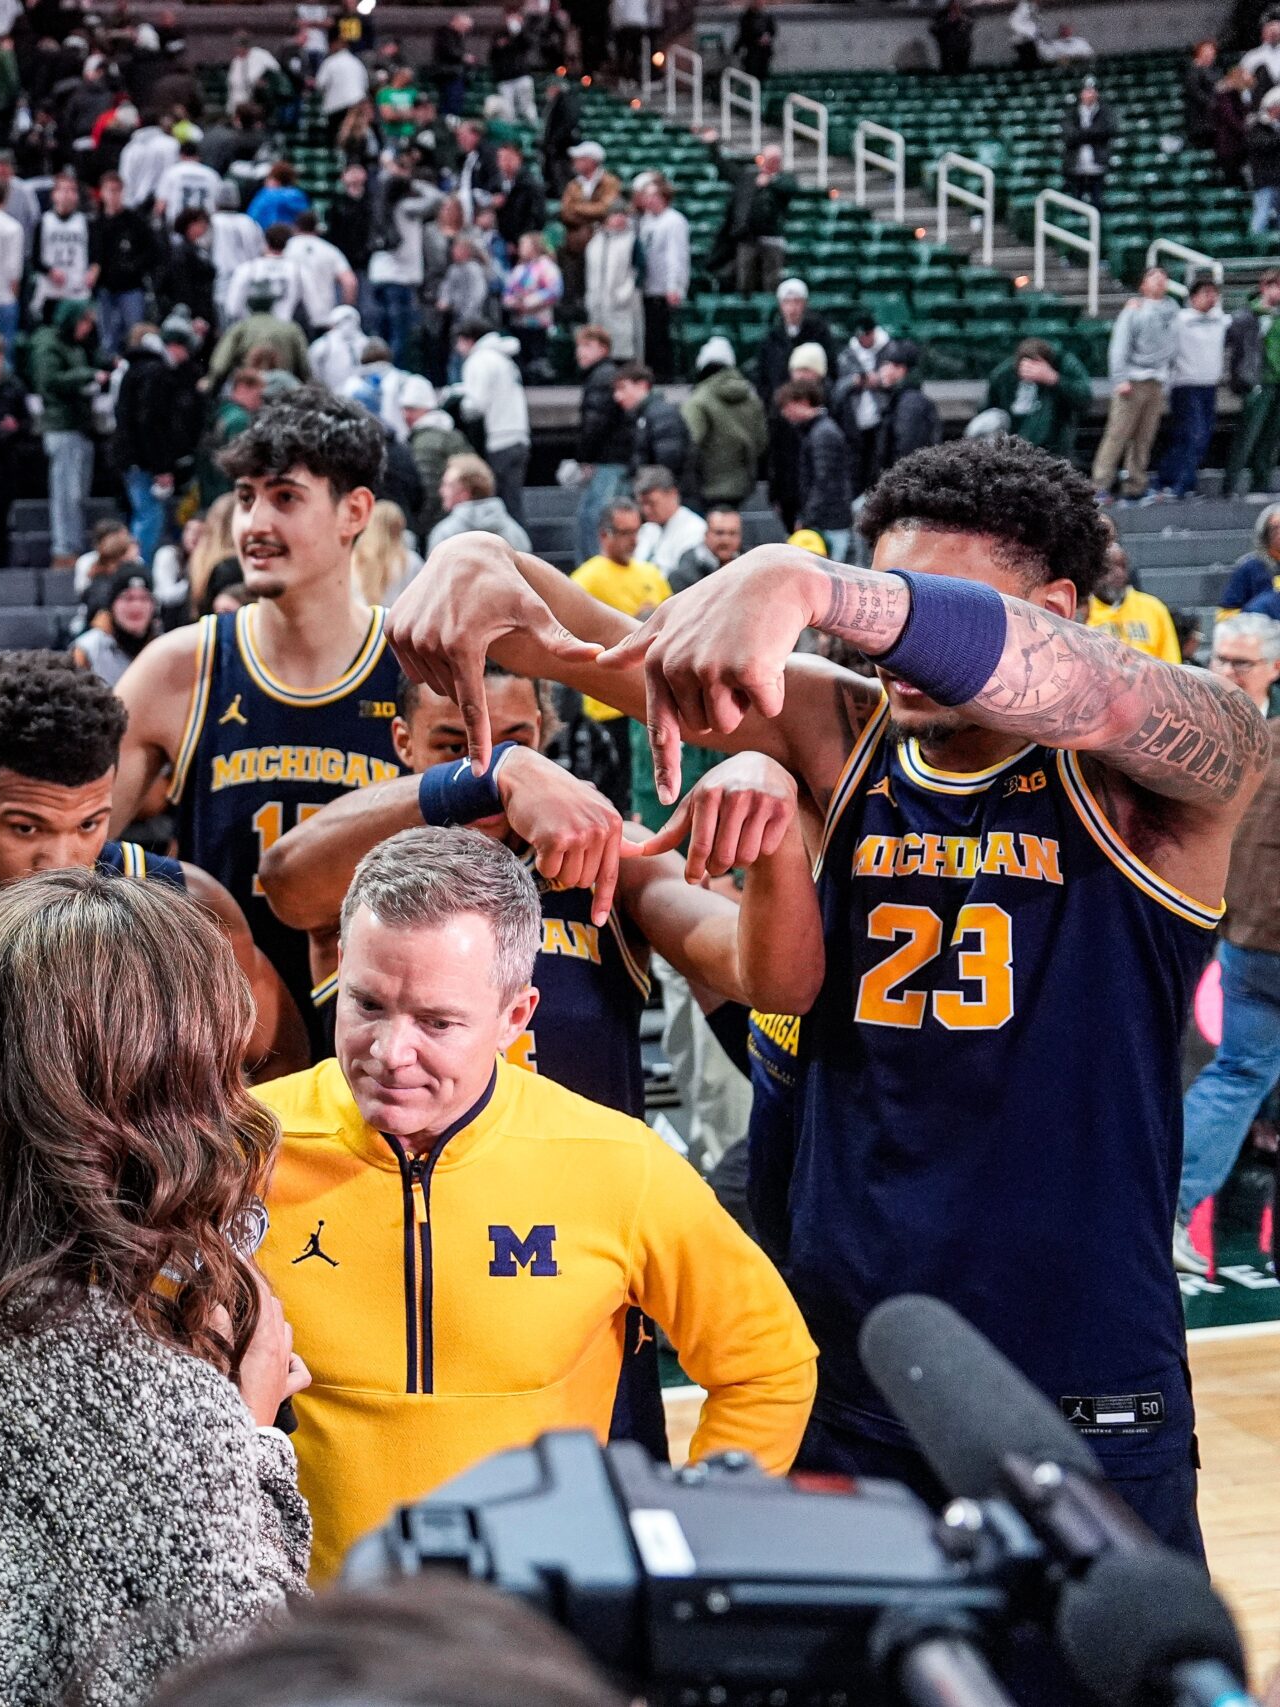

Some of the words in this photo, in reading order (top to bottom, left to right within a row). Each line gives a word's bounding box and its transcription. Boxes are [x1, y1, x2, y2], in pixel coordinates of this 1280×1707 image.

[852, 832, 1064, 886] MICHIAN
[854, 902, 1014, 1030] 23
[488, 1225, 557, 1277] M
[1141, 1401, 1159, 1416] 50
